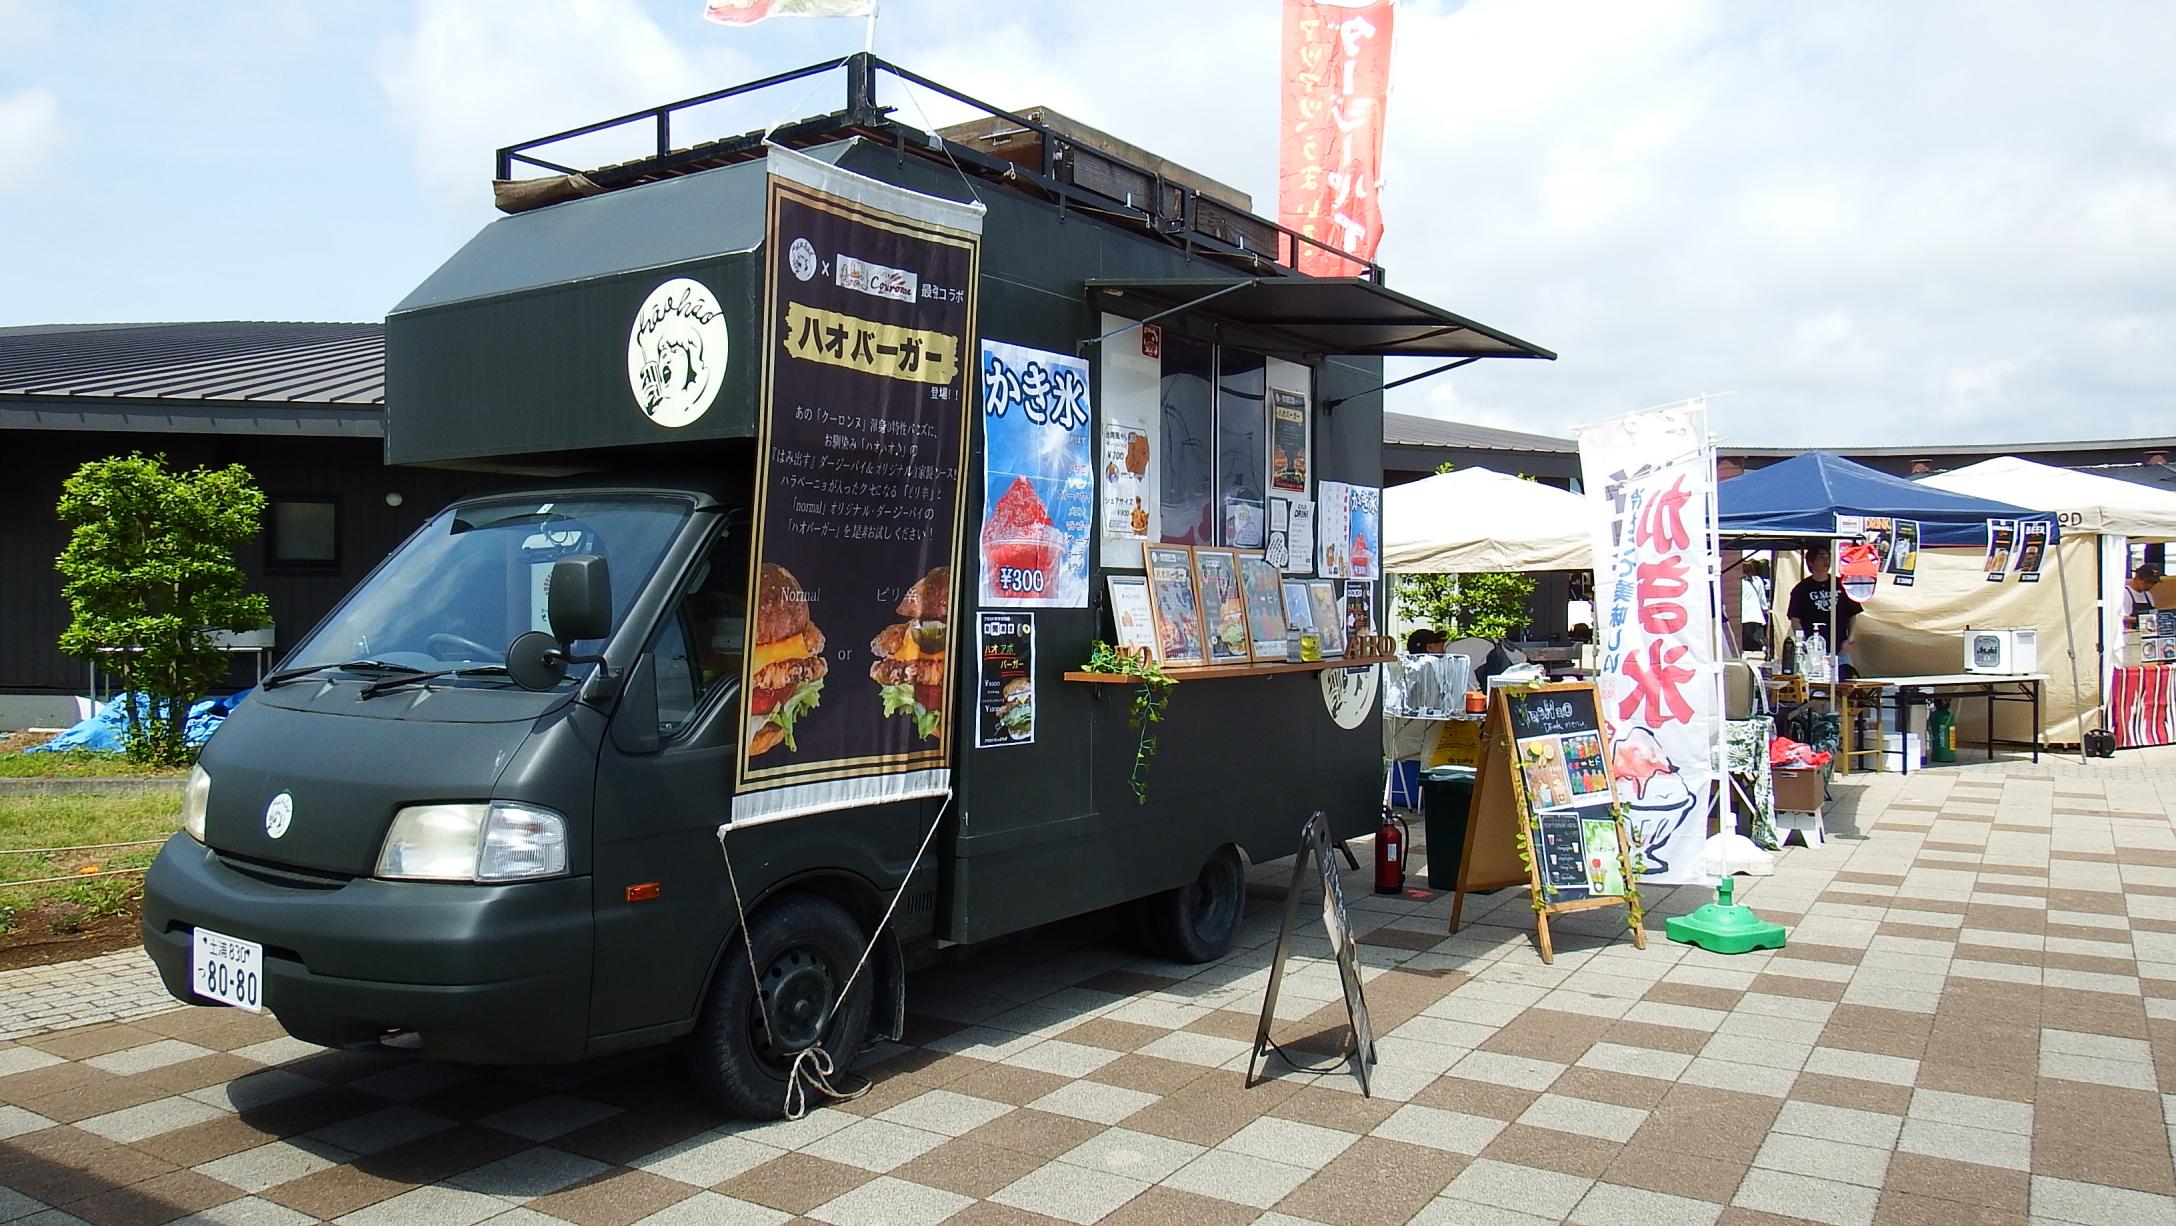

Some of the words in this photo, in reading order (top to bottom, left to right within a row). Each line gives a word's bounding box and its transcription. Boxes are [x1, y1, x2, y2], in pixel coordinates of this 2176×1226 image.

[798, 315, 942, 372] ハオバーガー
[985, 357, 1088, 431] かき氷
[1000, 567, 1044, 593] ¥300
[780, 586, 820, 602] Normal
[876, 587, 918, 603] ピリ辛
[838, 648, 852, 661] or
[1001, 660, 1024, 669] バーガー
[208, 960, 258, 1006] 80-80
